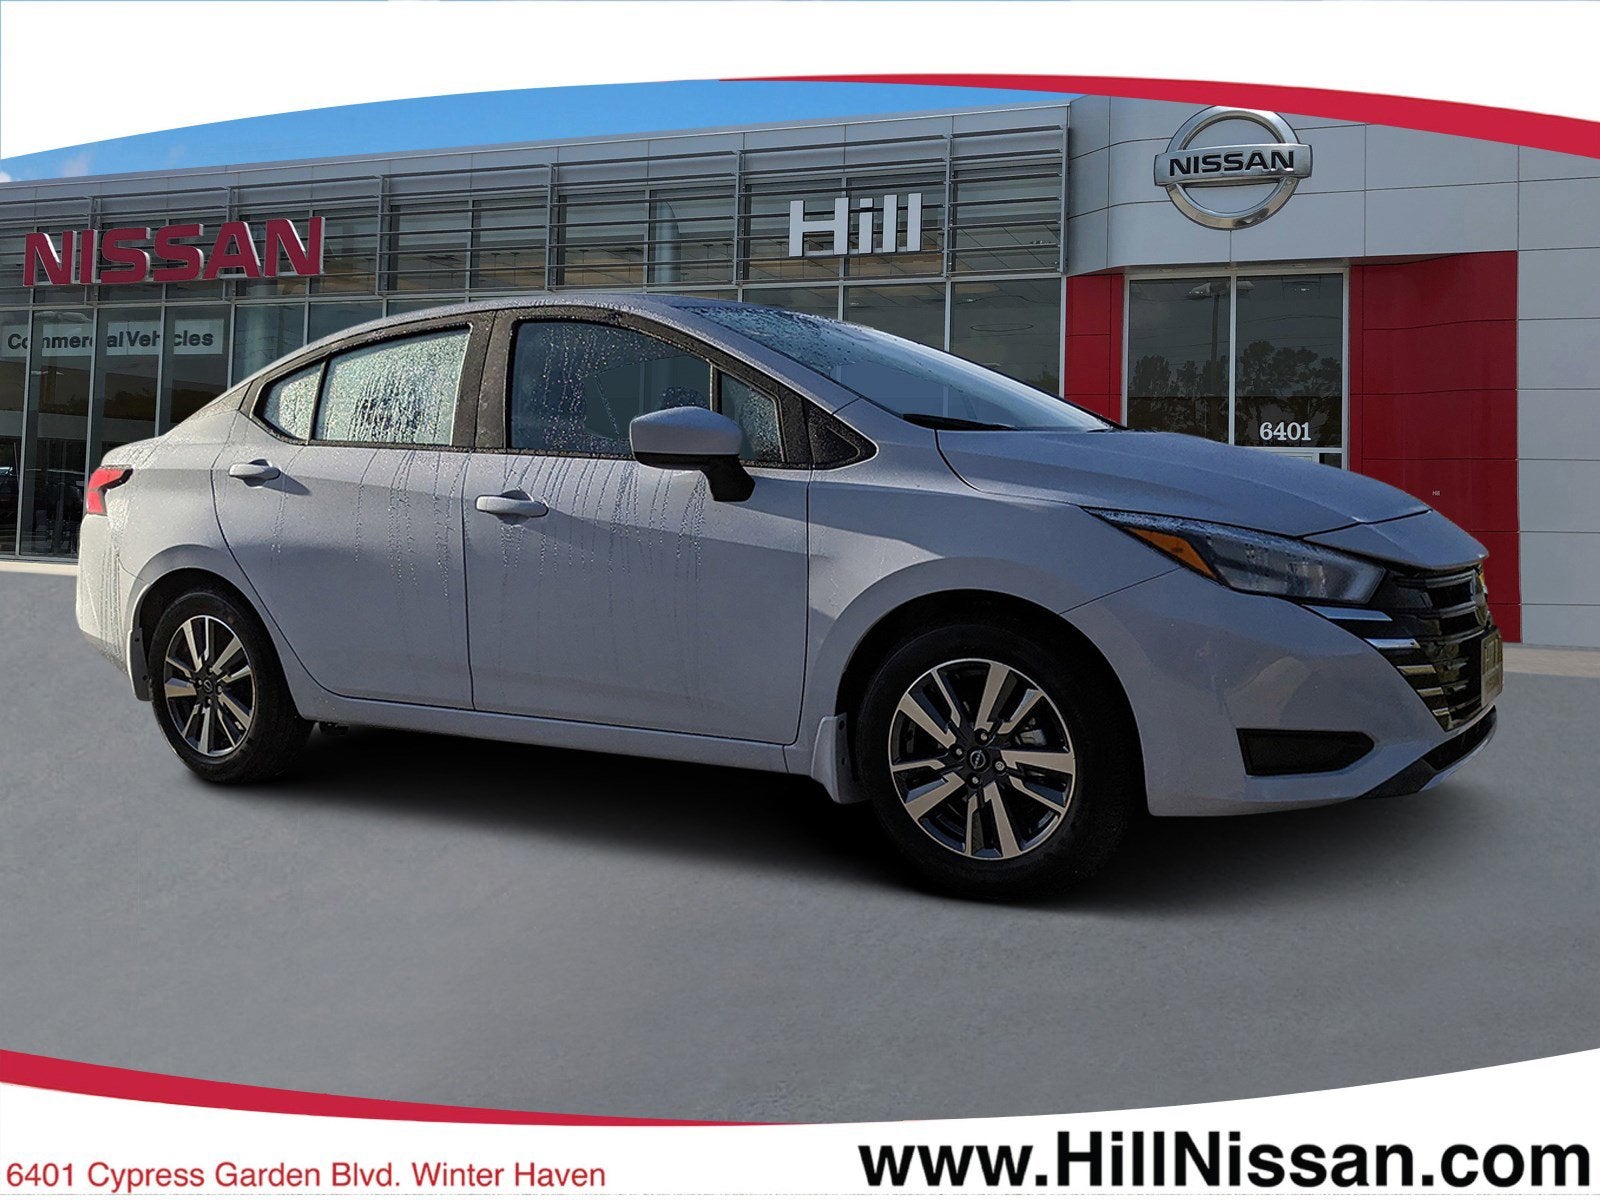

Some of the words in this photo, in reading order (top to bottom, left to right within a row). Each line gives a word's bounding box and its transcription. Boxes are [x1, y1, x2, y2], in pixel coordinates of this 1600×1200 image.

[1169, 149, 1294, 177] NISSAN
[788, 192, 922, 257] Hill
[23, 216, 325, 286] NISSAN
[8, 331, 124, 350] Commeral
[126, 330, 214, 347] Vehcles
[1259, 422, 1312, 441] 6401
